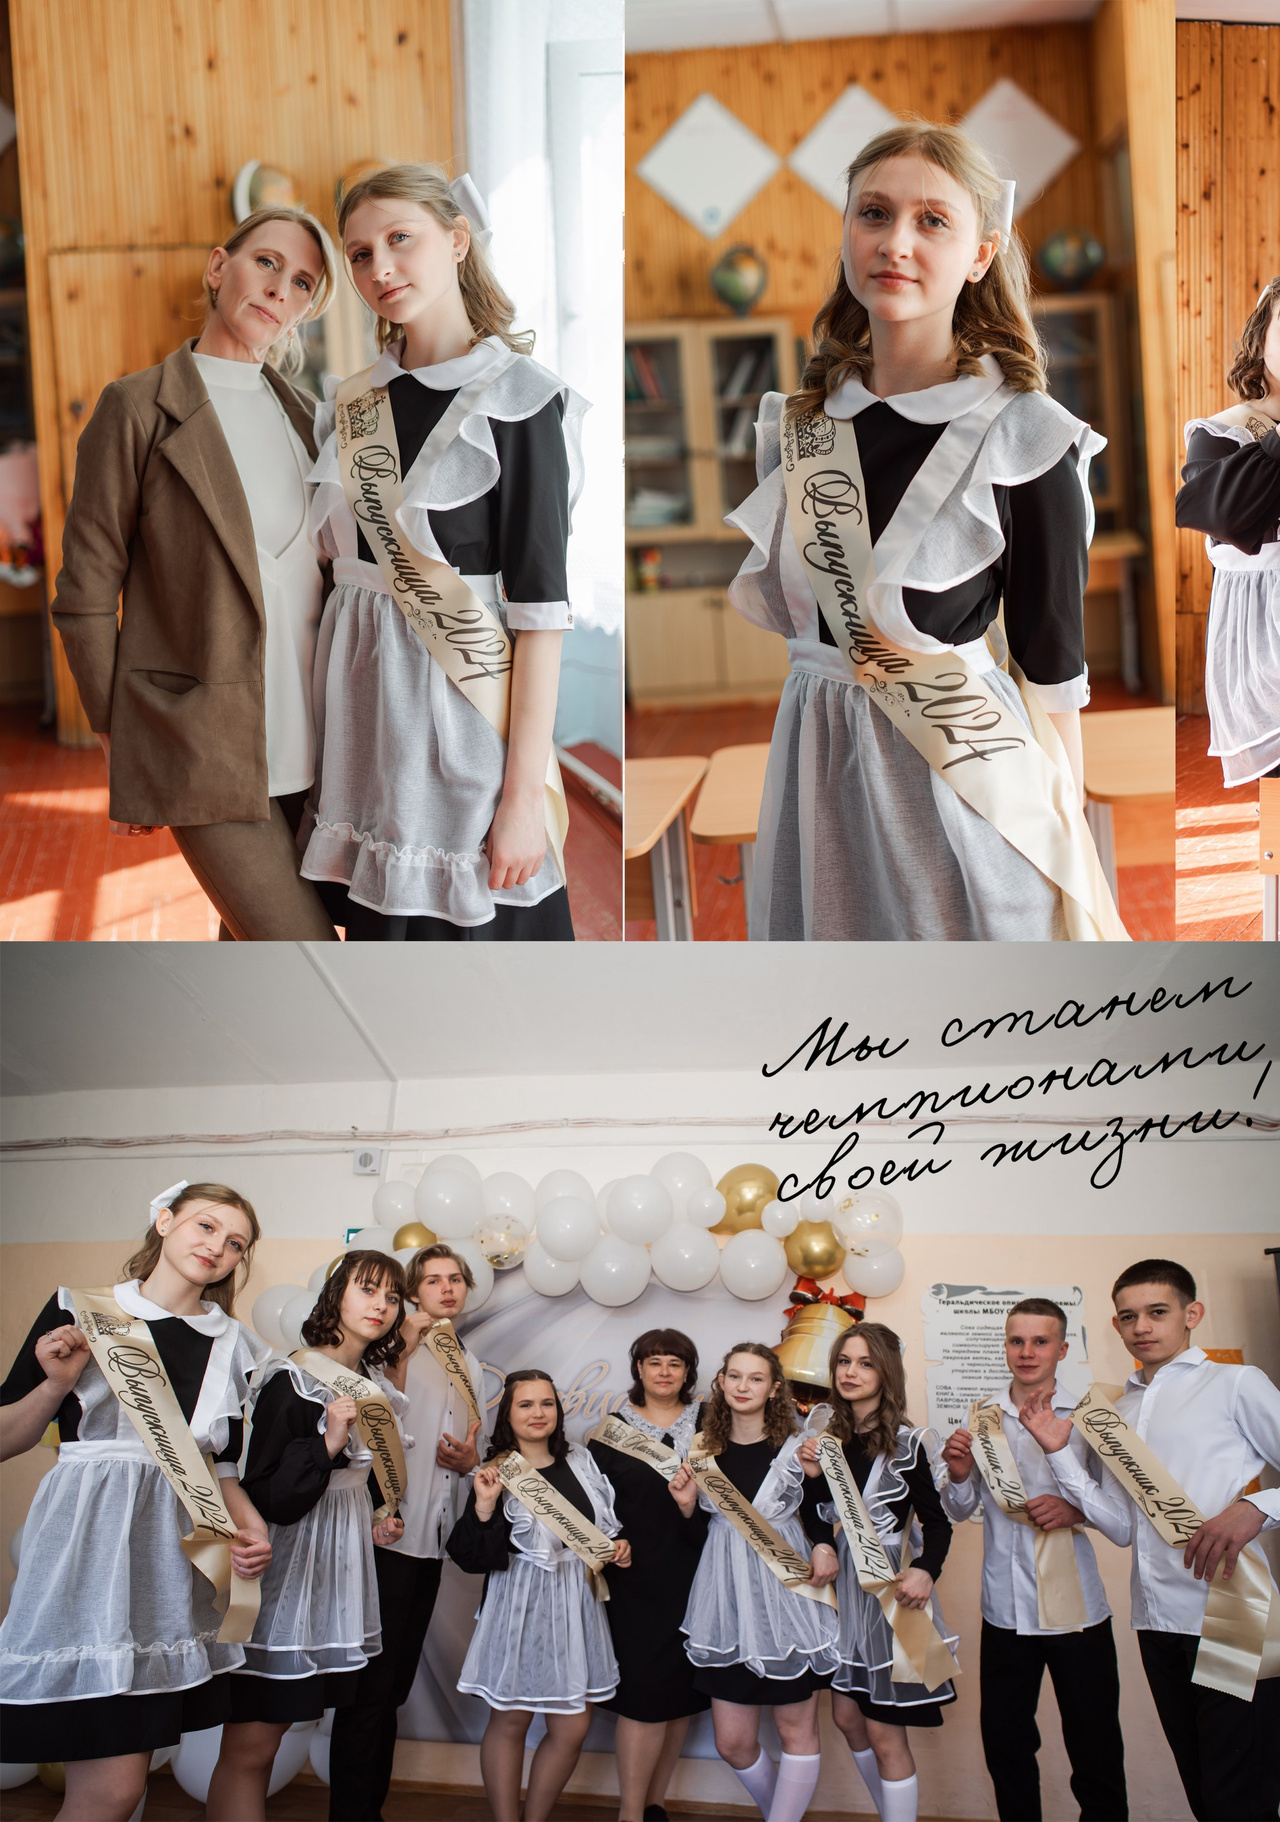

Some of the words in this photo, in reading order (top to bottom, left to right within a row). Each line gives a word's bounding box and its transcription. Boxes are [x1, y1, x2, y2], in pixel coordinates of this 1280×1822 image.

[350, 444, 443, 605] Выпускница
[427, 609, 513, 682] 2024
[801, 469, 914, 673] Выпускница
[895, 672, 1026, 770] 2024
[107, 1345, 187, 1477] Выпускница
[177, 1478, 234, 1540] 2024
[360, 1403, 401, 1495] Выпускница
[1082, 1408, 1160, 1496] Выпускник
[517, 1478, 591, 1545] Выпускница
[704, 1476, 775, 1547] Выпускница
[815, 1436, 864, 1531] Выпускница
[856, 1532, 895, 1583] 2024
